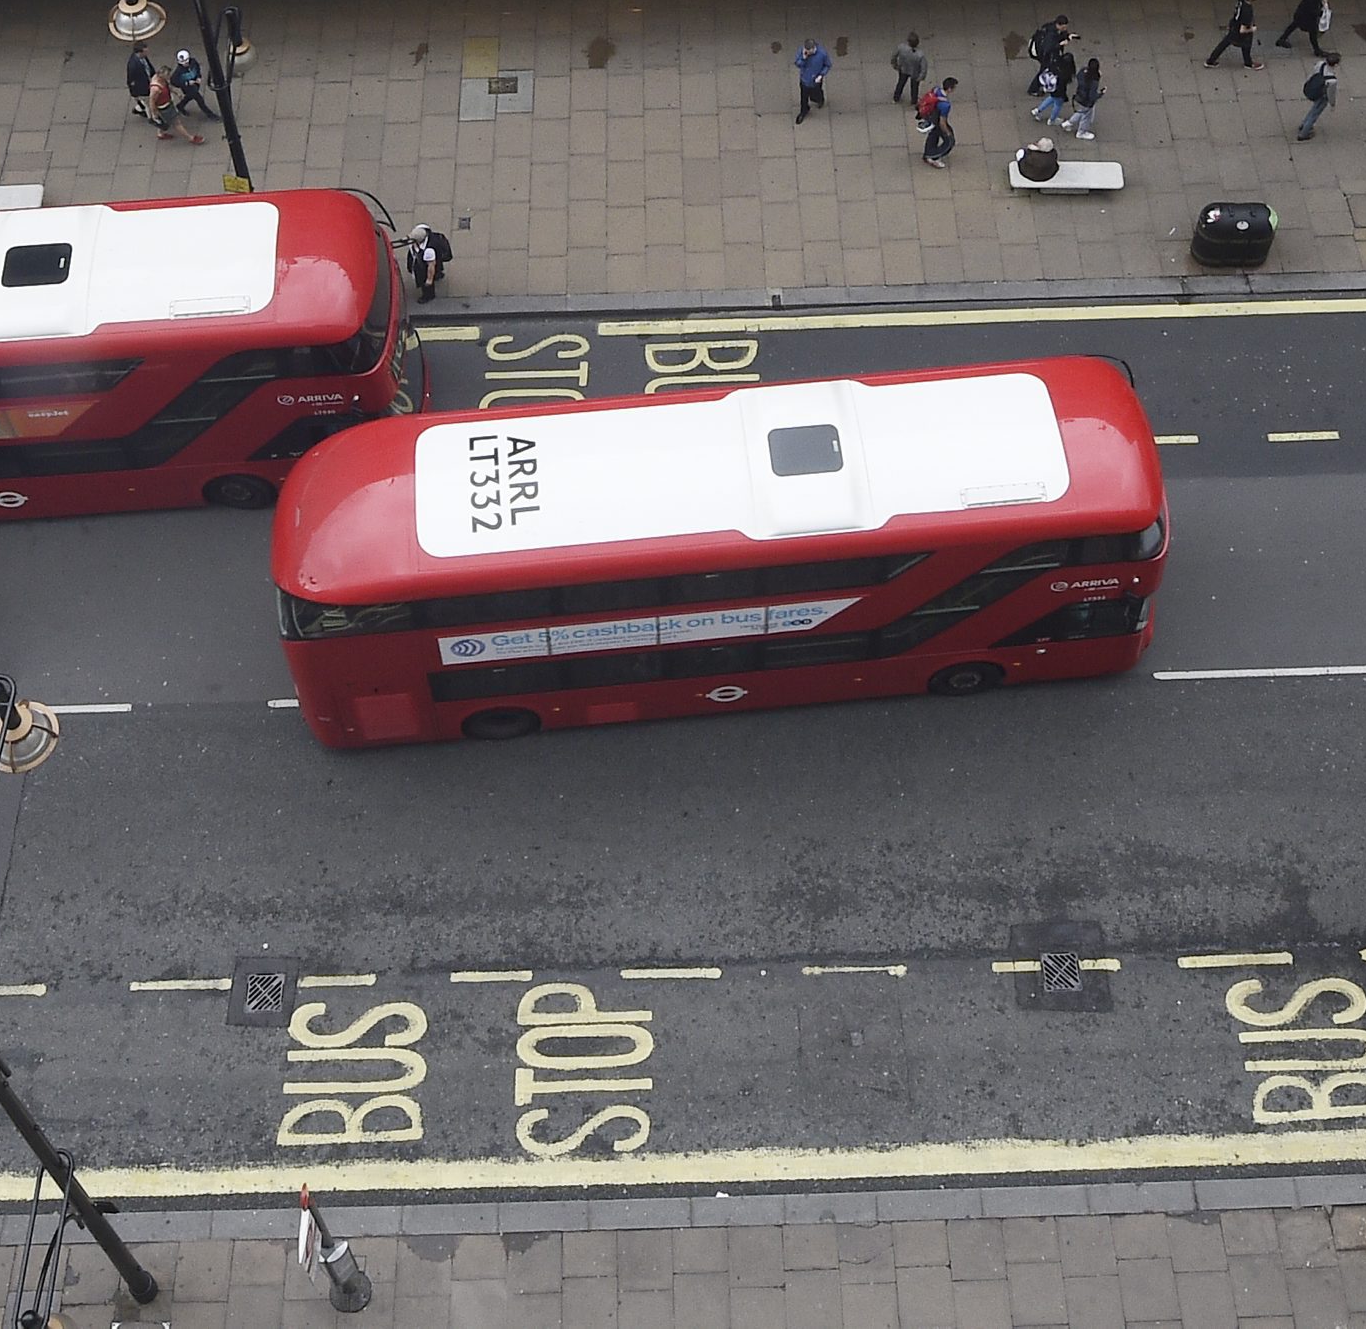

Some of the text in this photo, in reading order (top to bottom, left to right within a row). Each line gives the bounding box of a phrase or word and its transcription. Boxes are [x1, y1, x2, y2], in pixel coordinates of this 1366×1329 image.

[297, 393, 344, 403] ARRIVA
[469, 435, 502, 533] LT332
[506, 436, 540, 526] ARRL
[491, 633, 533, 647] Get
[538, 630, 570, 643] 5%
[573, 617, 682, 639] cashback
[686, 615, 714, 628] on
[721, 612, 762, 624] bus
[767, 606, 829, 619] fares.
[1070, 577, 1120, 589] ARRIVA
[276, 1001, 428, 1147] BUS
[514, 981, 655, 1157] STOP
